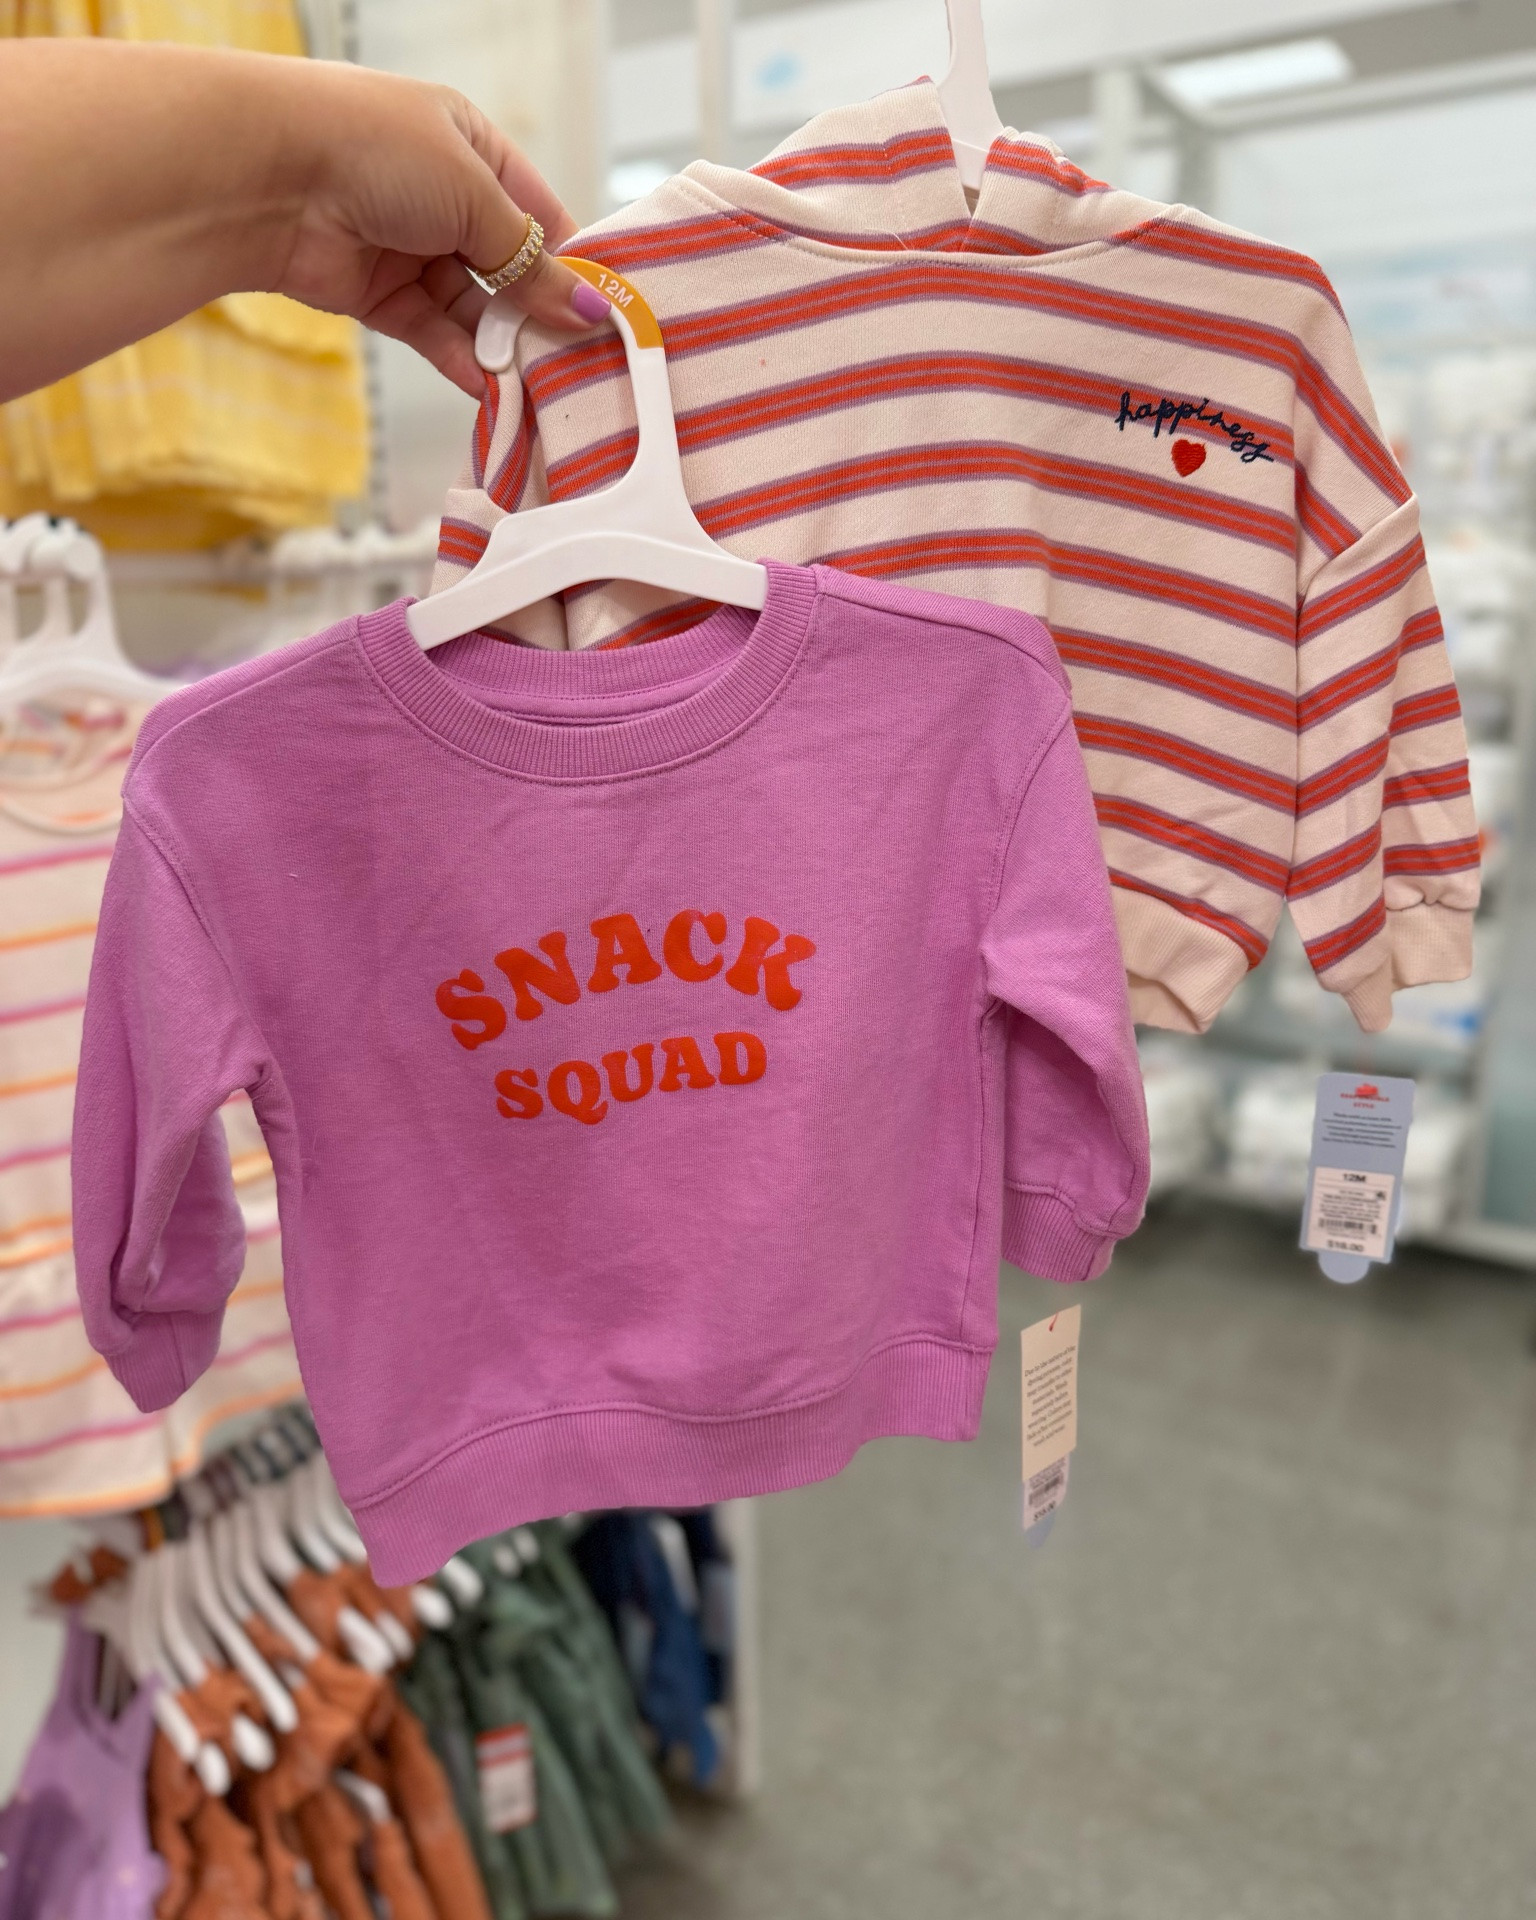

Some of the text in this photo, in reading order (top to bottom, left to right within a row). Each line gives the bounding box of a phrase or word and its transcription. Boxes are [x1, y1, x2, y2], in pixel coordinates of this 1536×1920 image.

[598, 273, 635, 308] 12M
[1114, 390, 1275, 464] happiness
[435, 908, 817, 1051] SNACK
[494, 1031, 768, 1125] SQUAD
